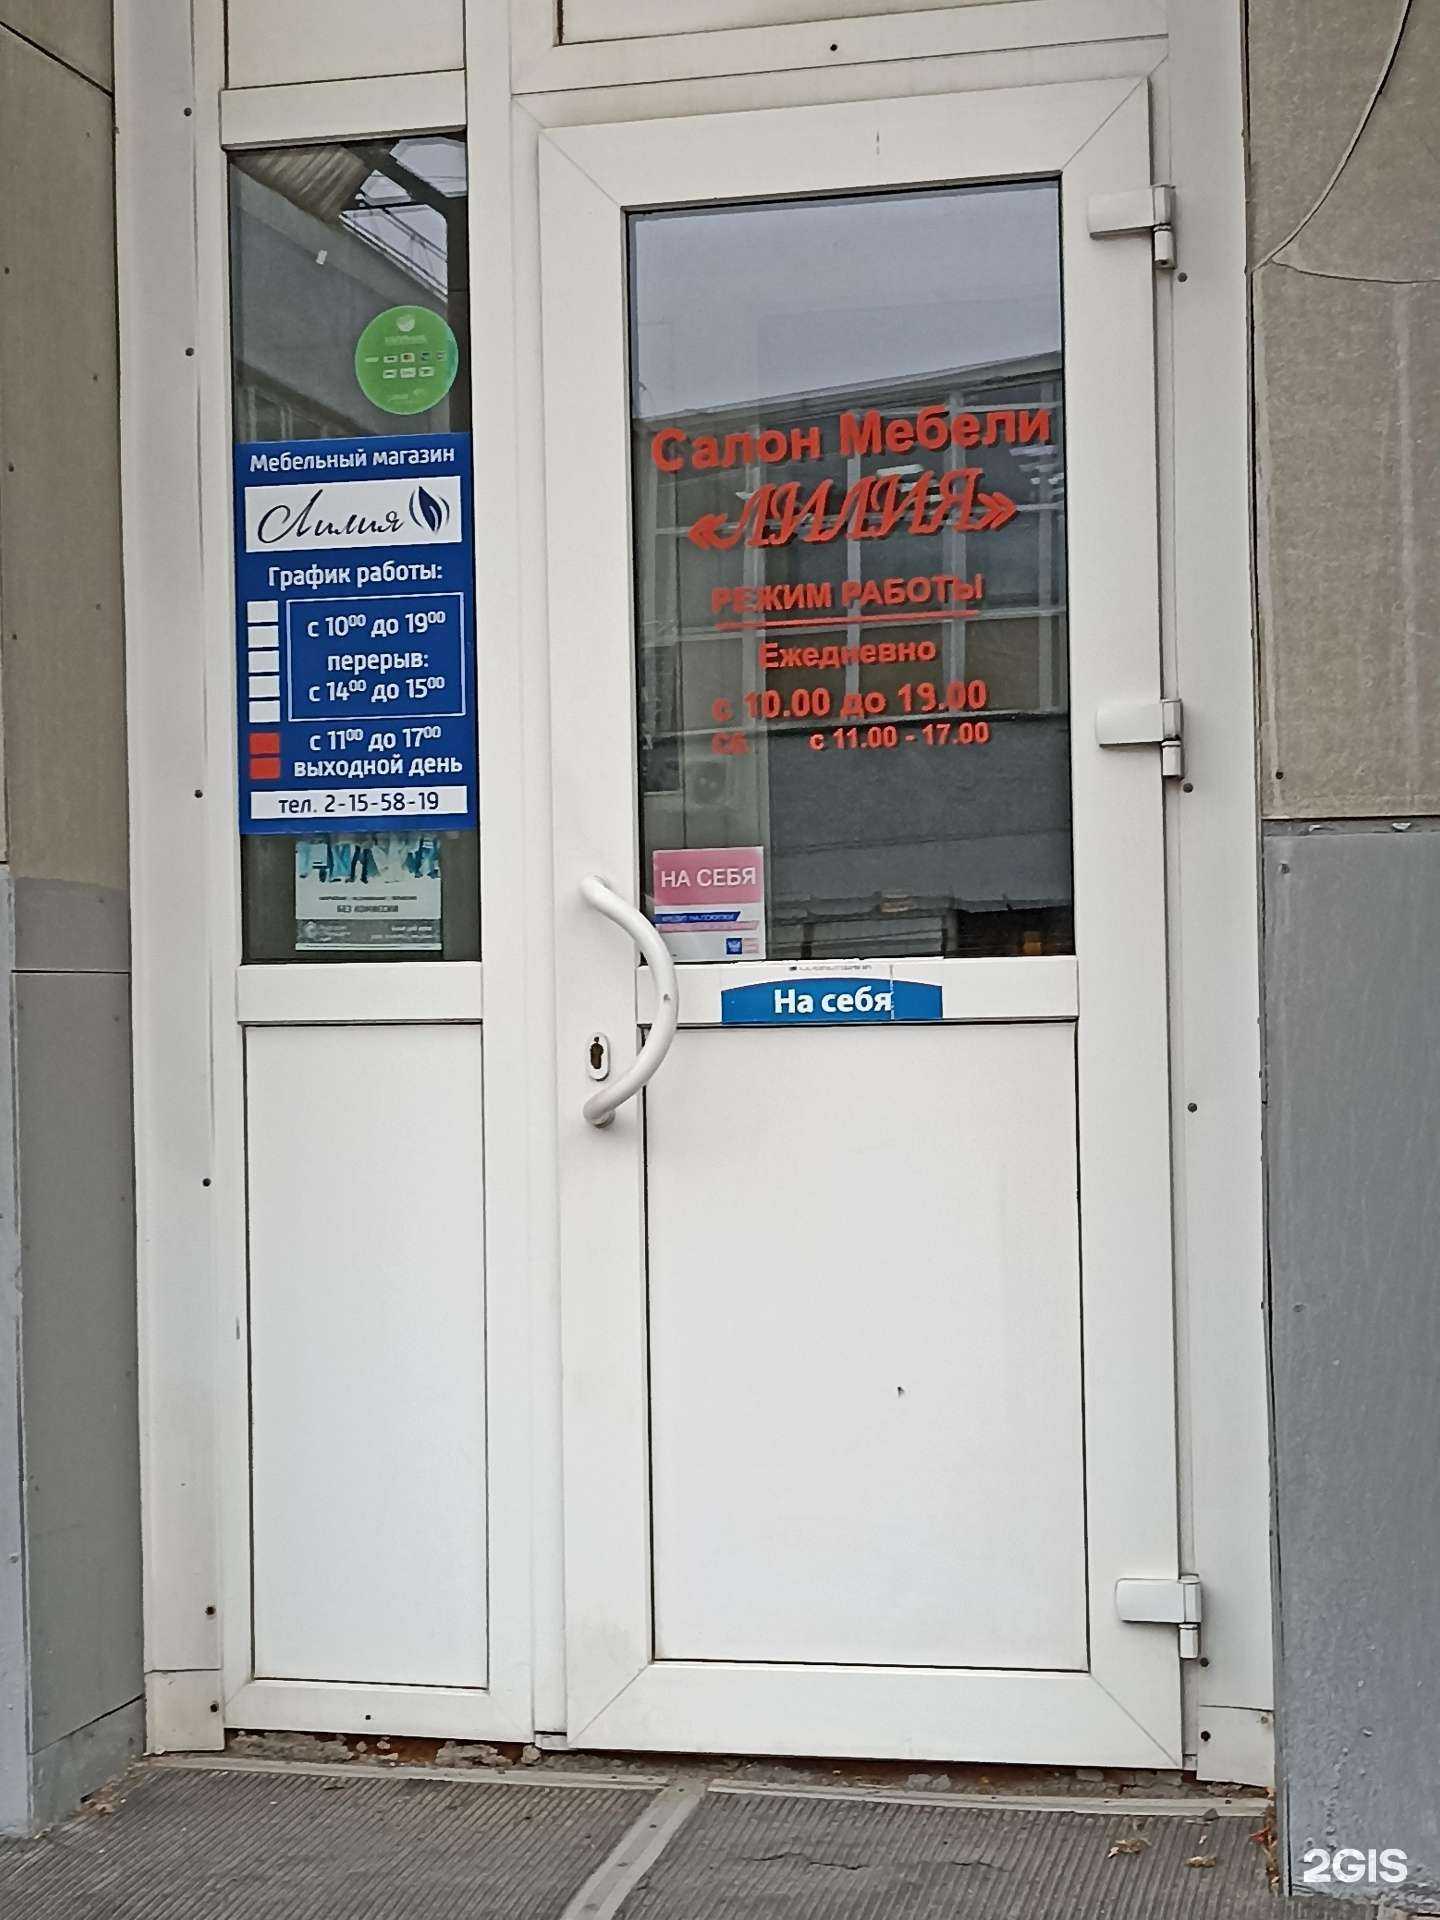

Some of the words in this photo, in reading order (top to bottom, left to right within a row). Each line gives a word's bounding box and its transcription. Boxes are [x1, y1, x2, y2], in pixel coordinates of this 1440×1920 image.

[651, 424, 821, 473] Салон
[840, 405, 1051, 456] Мебели
[250, 449, 367, 472] Мебельный
[373, 447, 455, 467] магазин
[257, 489, 404, 543] Лилия
[269, 564, 350, 591] График
[357, 560, 443, 587] работы:
[711, 581, 832, 613] РЕЖИМ
[841, 573, 983, 606] РАБОТЫ
[370, 618, 399, 638] до
[327, 652, 430, 675] перерыв:
[759, 640, 936, 669] Ежедневно
[372, 682, 401, 703] до
[744, 688, 830, 719] 10.00
[840, 691, 886, 719] до
[898, 680, 988, 712] 19.00
[368, 731, 396, 752] до
[833, 725, 898, 749] 11.00
[922, 722, 989, 746] 17.00
[294, 754, 403, 779] выходной
[409, 756, 463, 776] день
[279, 798, 317, 814] тел.
[324, 792, 440, 813] 2-15-58-19
[660, 870, 691, 888] НА
[697, 867, 757, 887] СЕБЯ
[774, 989, 814, 1014] На
[821, 986, 893, 1014] себя
